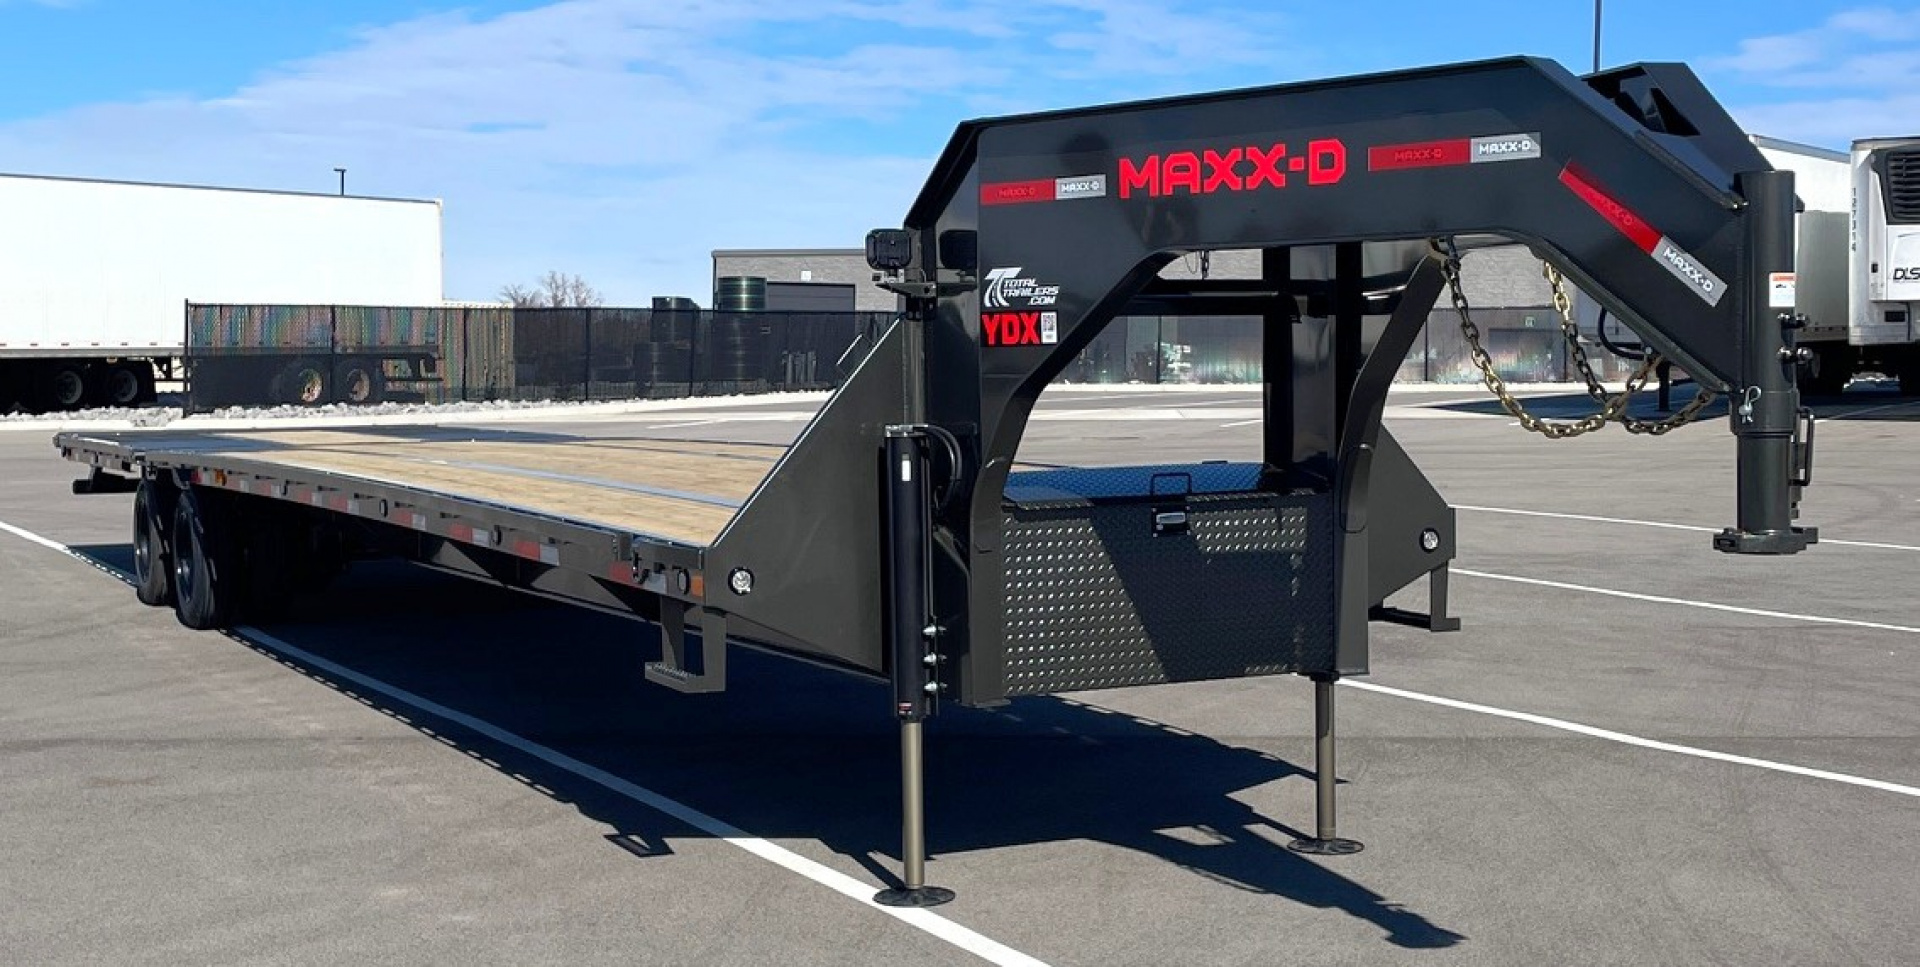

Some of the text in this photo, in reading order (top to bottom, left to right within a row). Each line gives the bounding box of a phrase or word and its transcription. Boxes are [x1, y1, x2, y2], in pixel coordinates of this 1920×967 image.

[1479, 140, 1531, 154] MAXX-D
[1119, 139, 1347, 199] MAXX-D
[1663, 247, 1714, 292] MAXX-D
[981, 312, 1040, 345] YDX
